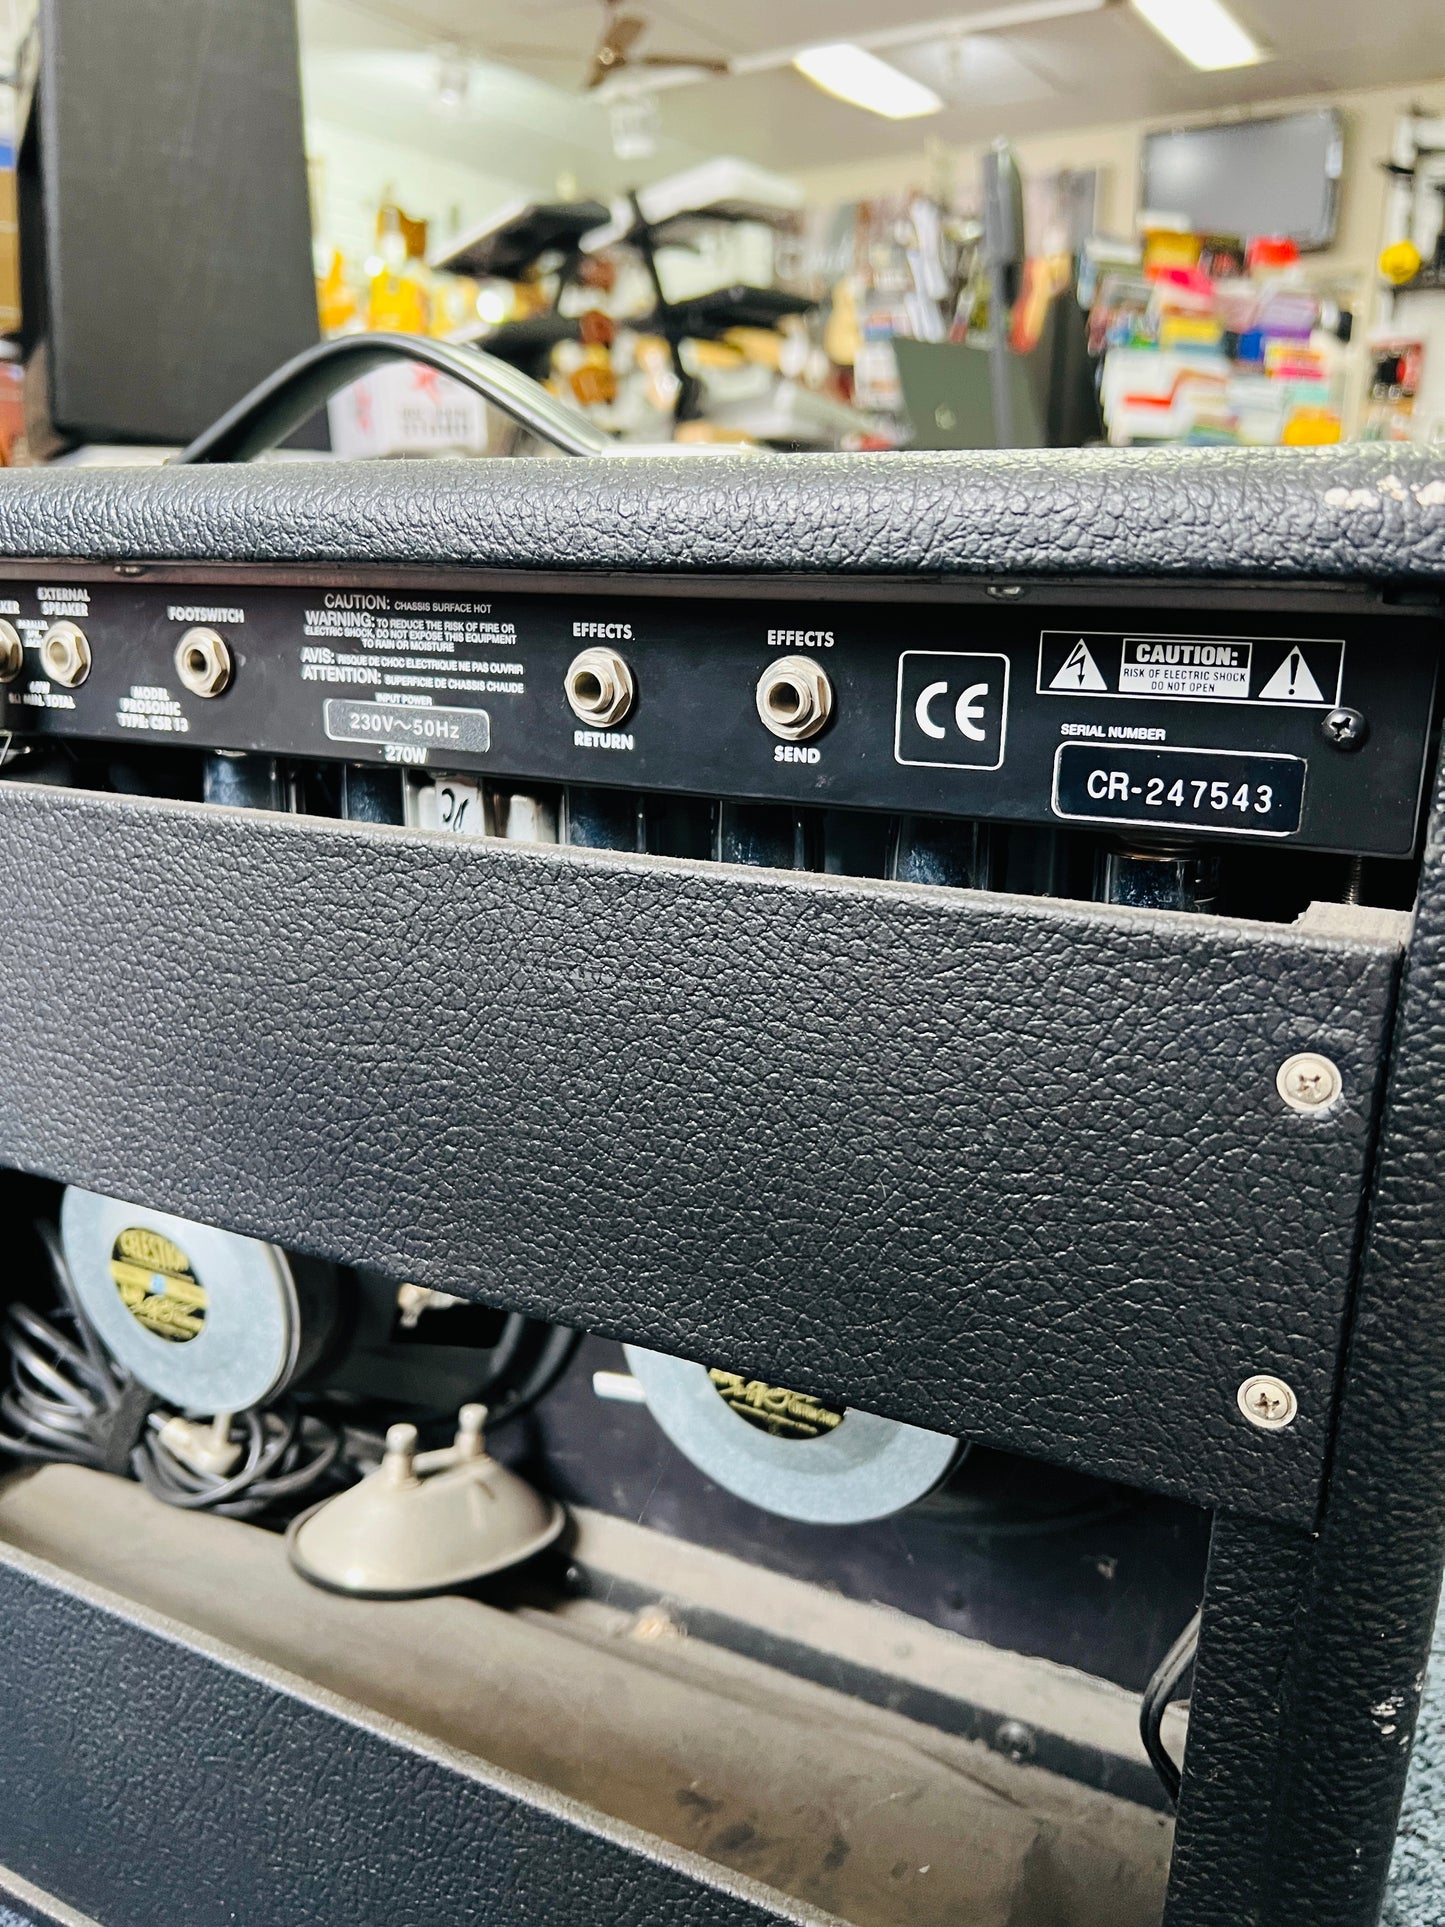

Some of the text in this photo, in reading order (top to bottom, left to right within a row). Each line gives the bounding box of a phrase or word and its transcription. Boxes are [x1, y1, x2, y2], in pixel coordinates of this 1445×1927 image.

[37, 587, 91, 602] EXTERNAL
[324, 594, 492, 614] CAUTION: CHASSIS SURFACE HOT
[41, 602, 89, 616] SPEAKER
[167, 606, 245, 623] FOOTSWITCH
[304, 610, 515, 634] WARNING: TO REDUCE THE RISK OF FIRE OR
[572, 622, 633, 640] EFFECTS
[304, 625, 518, 645] ELECTRIC SHOCK, DO NOT EXPOSE THIS EQUIPMENT
[766, 629, 835, 648] EFFECTS
[361, 639, 455, 653] TO RAIN OR MOISTURE
[1135, 643, 1239, 666] CAUTION:
[301, 647, 524, 675] AVIS: RISQUE DE CHOC ELECTRIQUE NE PAS OUVRIR
[302, 665, 525, 694] ATTENTION: SUPERFICIE DE CHASSIS CHAUDE
[1123, 667, 1247, 683] RISK OF ELECTRIC SHOCK
[1151, 681, 1216, 693] DO NOT OPEN
[374, 692, 433, 706] INPUT POWER
[914, 680, 989, 741] CE
[573, 730, 634, 751] RETURN
[1060, 723, 1166, 742] SERIAL NUMBER
[384, 746, 428, 764] 270W
[773, 745, 821, 764] SEND
[1086, 769, 1275, 815] CR-247543
